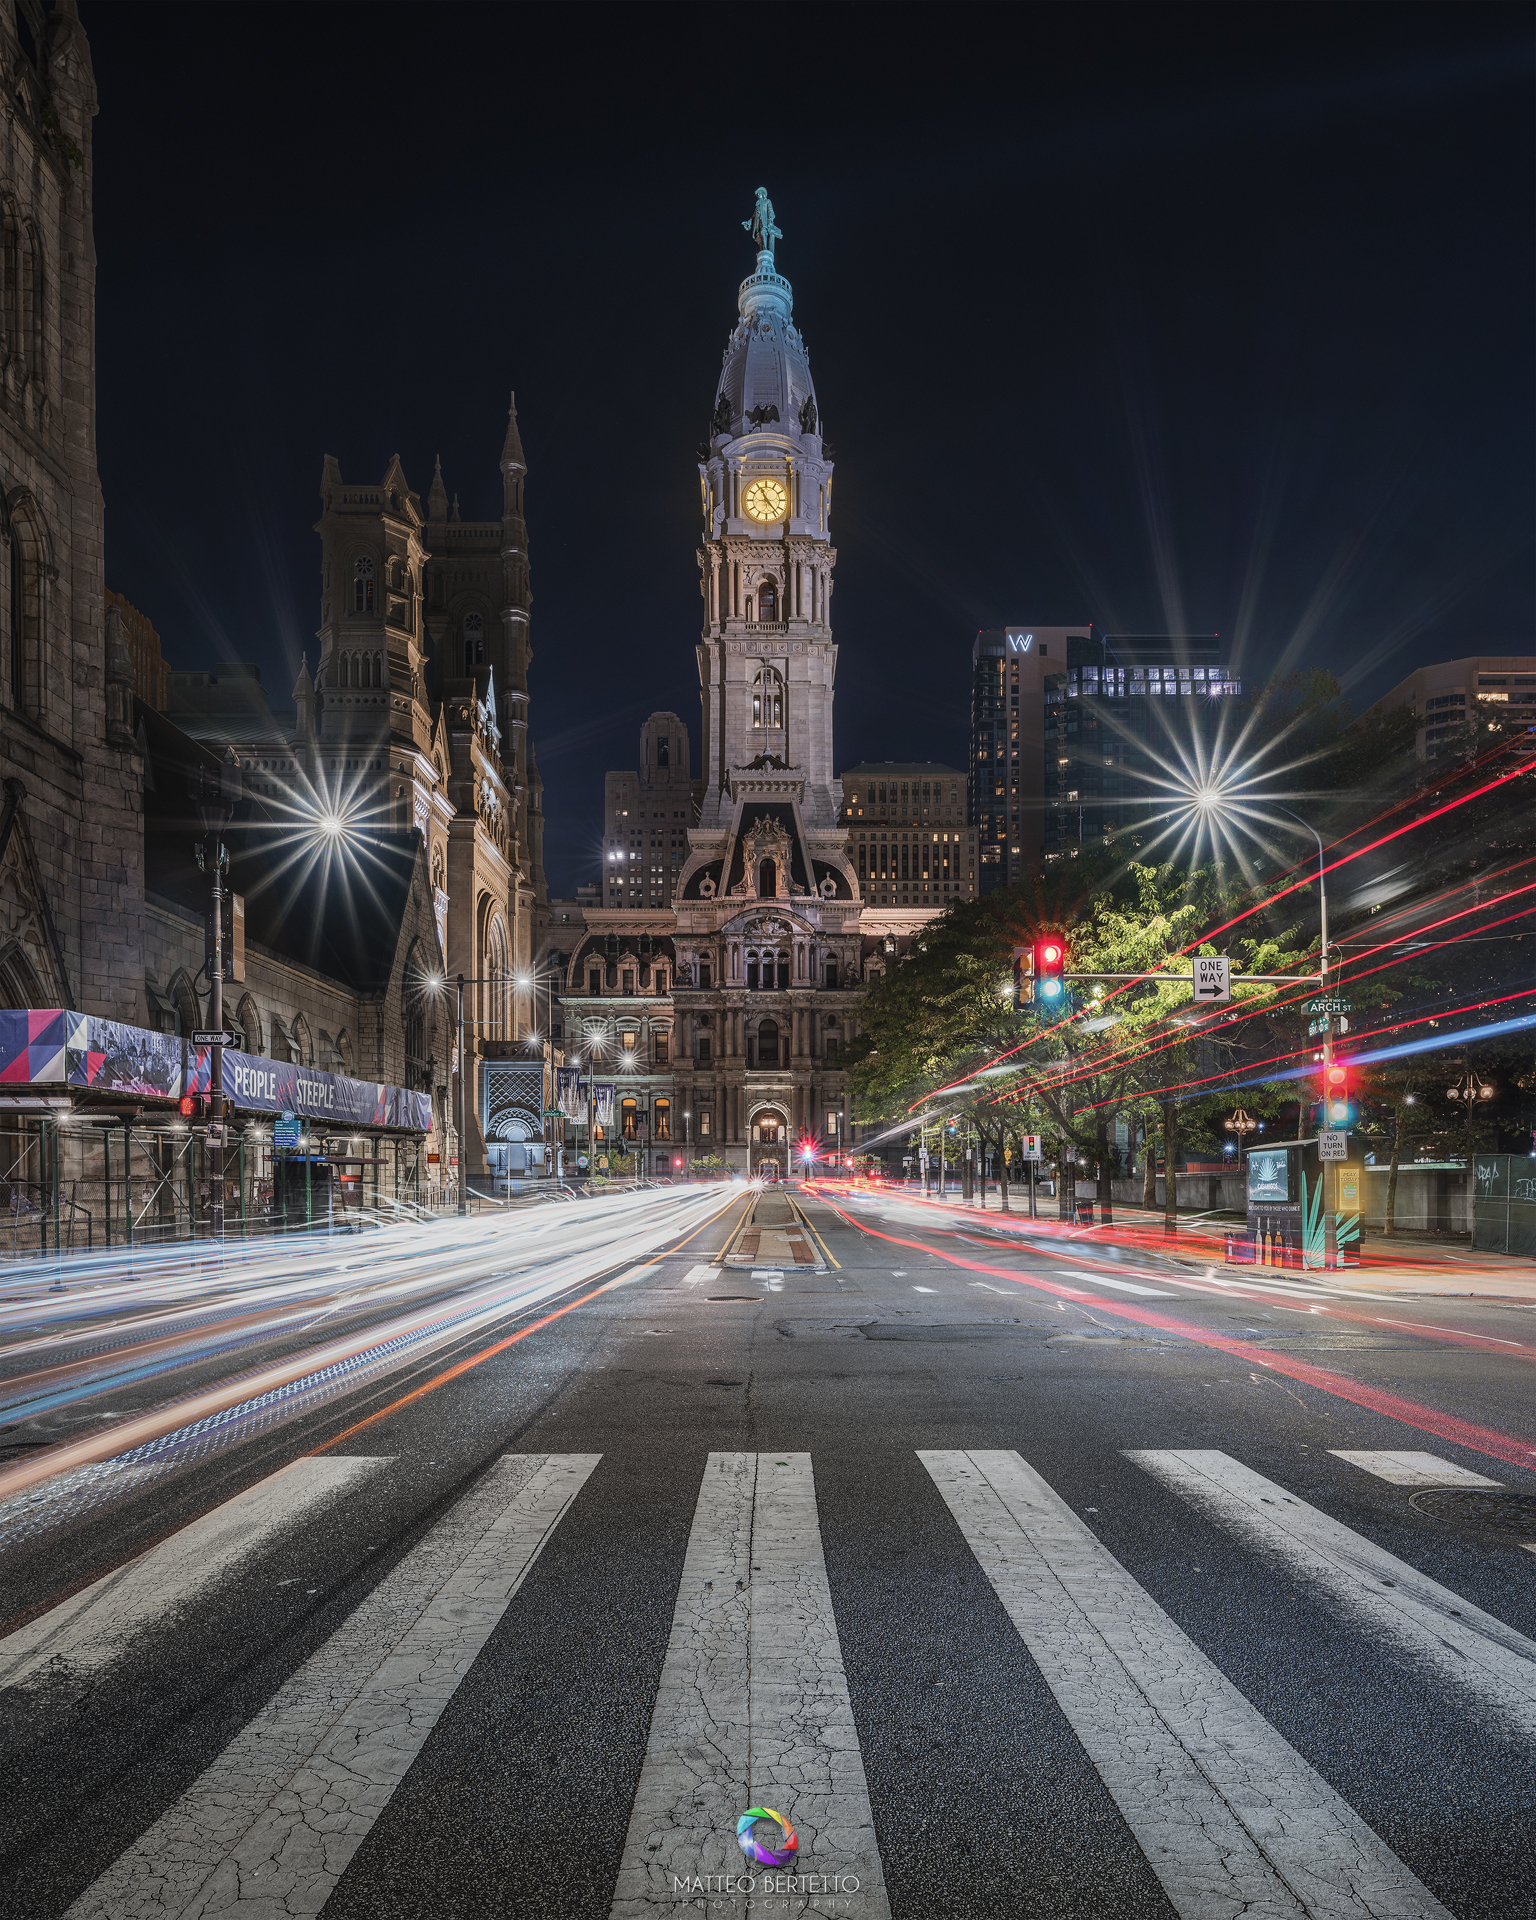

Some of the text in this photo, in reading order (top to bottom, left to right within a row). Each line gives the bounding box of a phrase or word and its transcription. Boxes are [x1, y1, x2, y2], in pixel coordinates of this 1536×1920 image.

[1008, 634, 1033, 651] W
[1200, 961, 1223, 971] ONE
[1200, 972, 1224, 983] WAY
[1310, 1002, 1352, 1012] ARCH ST
[234, 1065, 277, 1101] PEOPLE
[296, 1078, 335, 1109] STEEPLE
